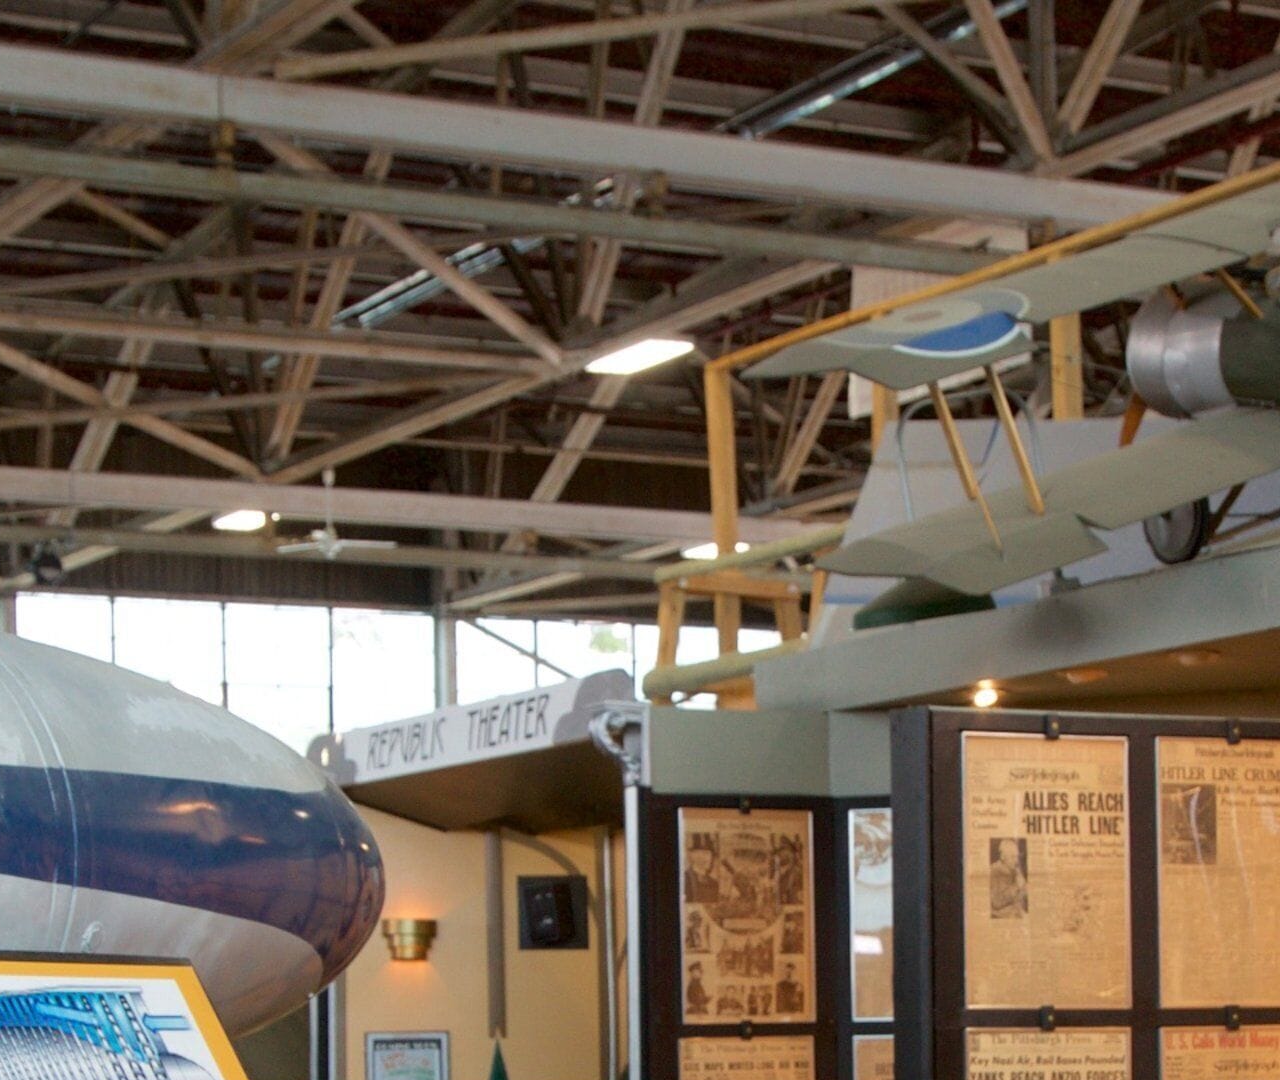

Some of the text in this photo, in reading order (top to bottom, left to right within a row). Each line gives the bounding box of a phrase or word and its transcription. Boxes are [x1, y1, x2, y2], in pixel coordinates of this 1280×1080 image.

[467, 693, 550, 750] THEATER
[1023, 790, 1124, 812] ALLIES REACH
